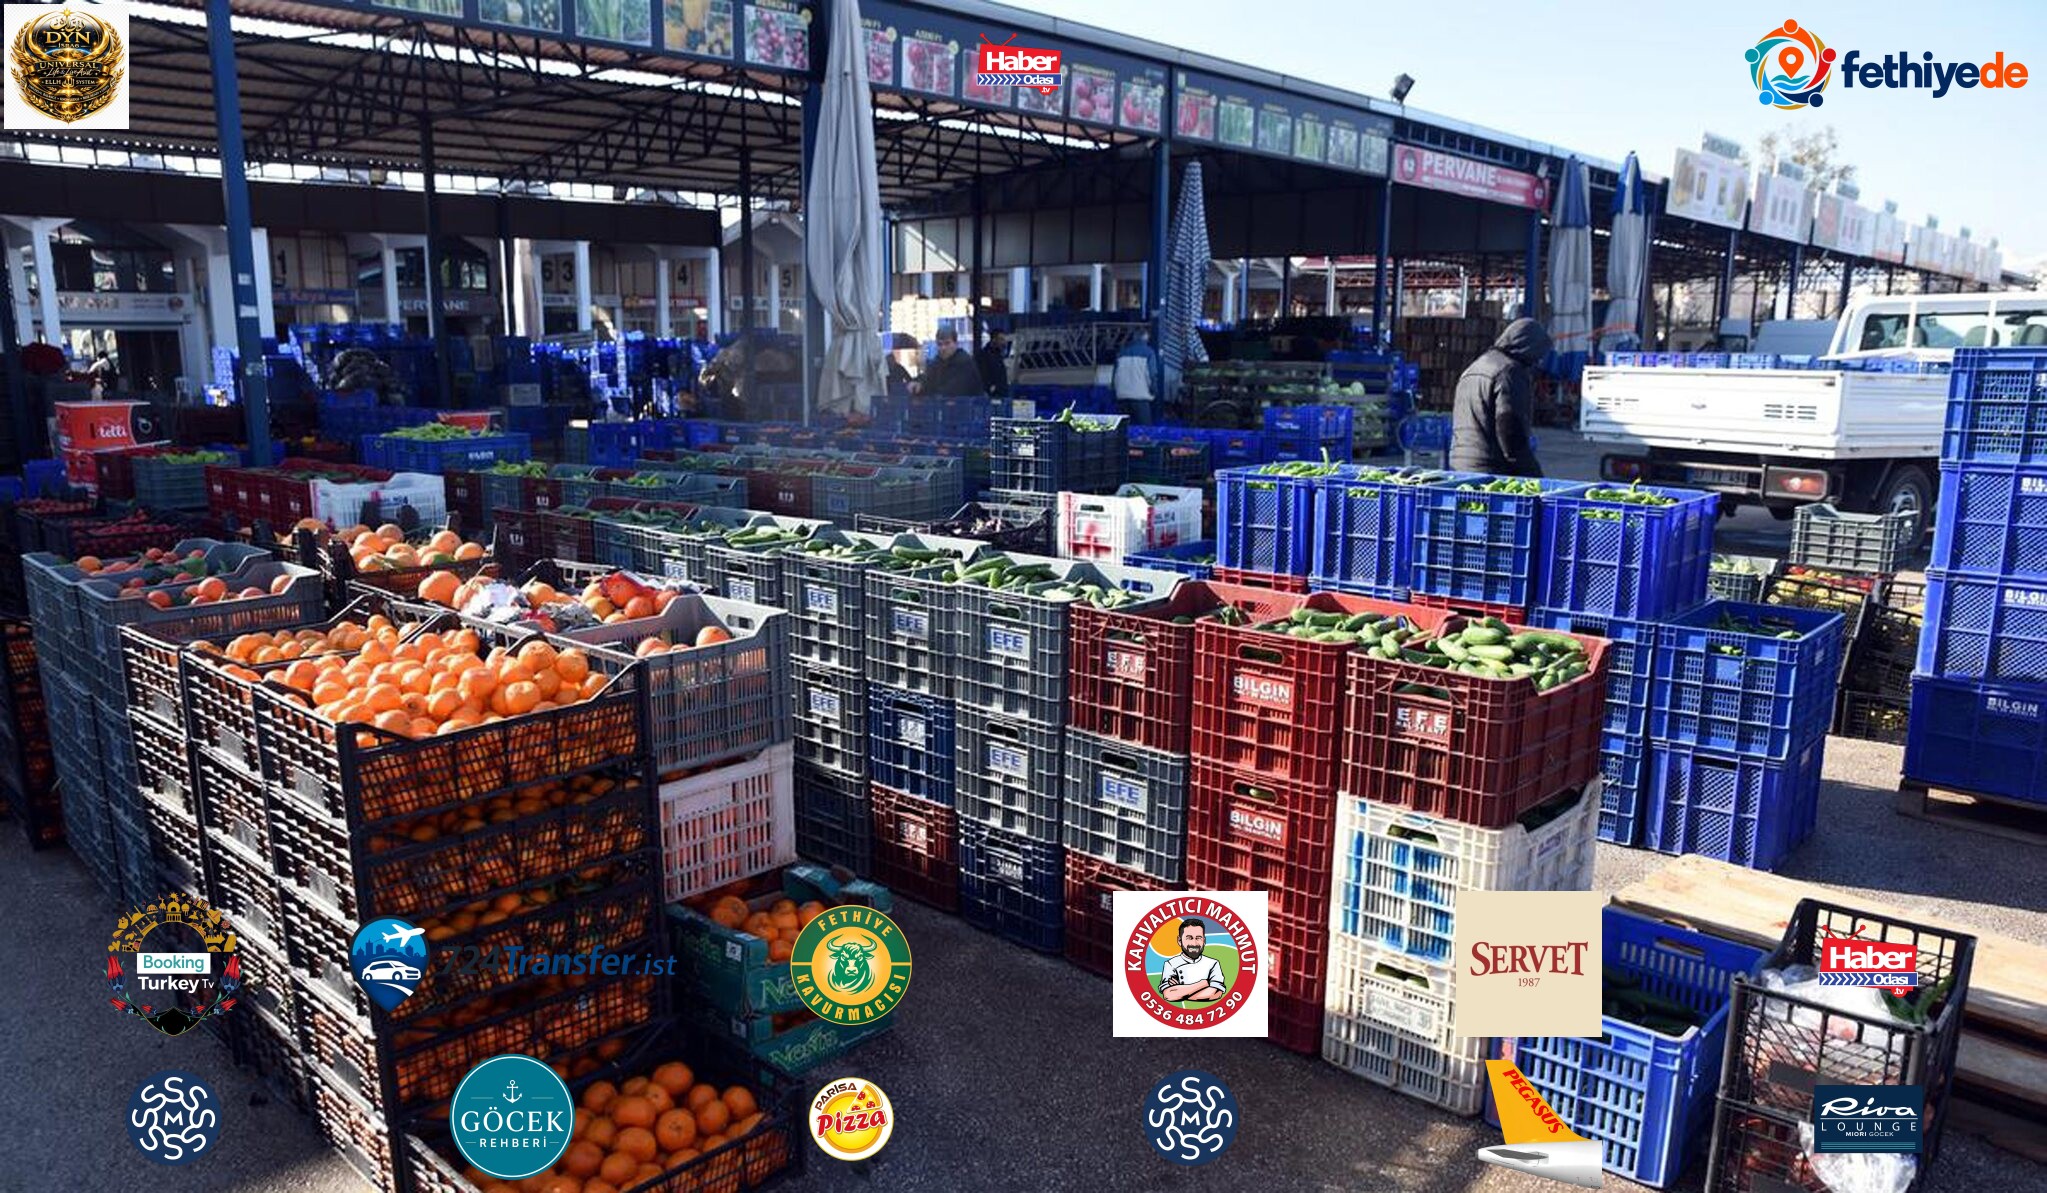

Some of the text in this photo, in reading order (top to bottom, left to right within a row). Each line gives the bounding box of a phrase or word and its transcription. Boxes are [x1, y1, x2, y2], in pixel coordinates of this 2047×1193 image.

[1421, 151, 1498, 187] PERVANE
[677, 258, 688, 285] 4
[810, 591, 833, 607] EFE
[897, 616, 926, 631] EFE
[992, 630, 1024, 650] EFE
[812, 697, 835, 712] EFE
[1397, 707, 1448, 727] EFE
[991, 750, 1022, 768] EFE
[1105, 780, 1140, 800] EFE
